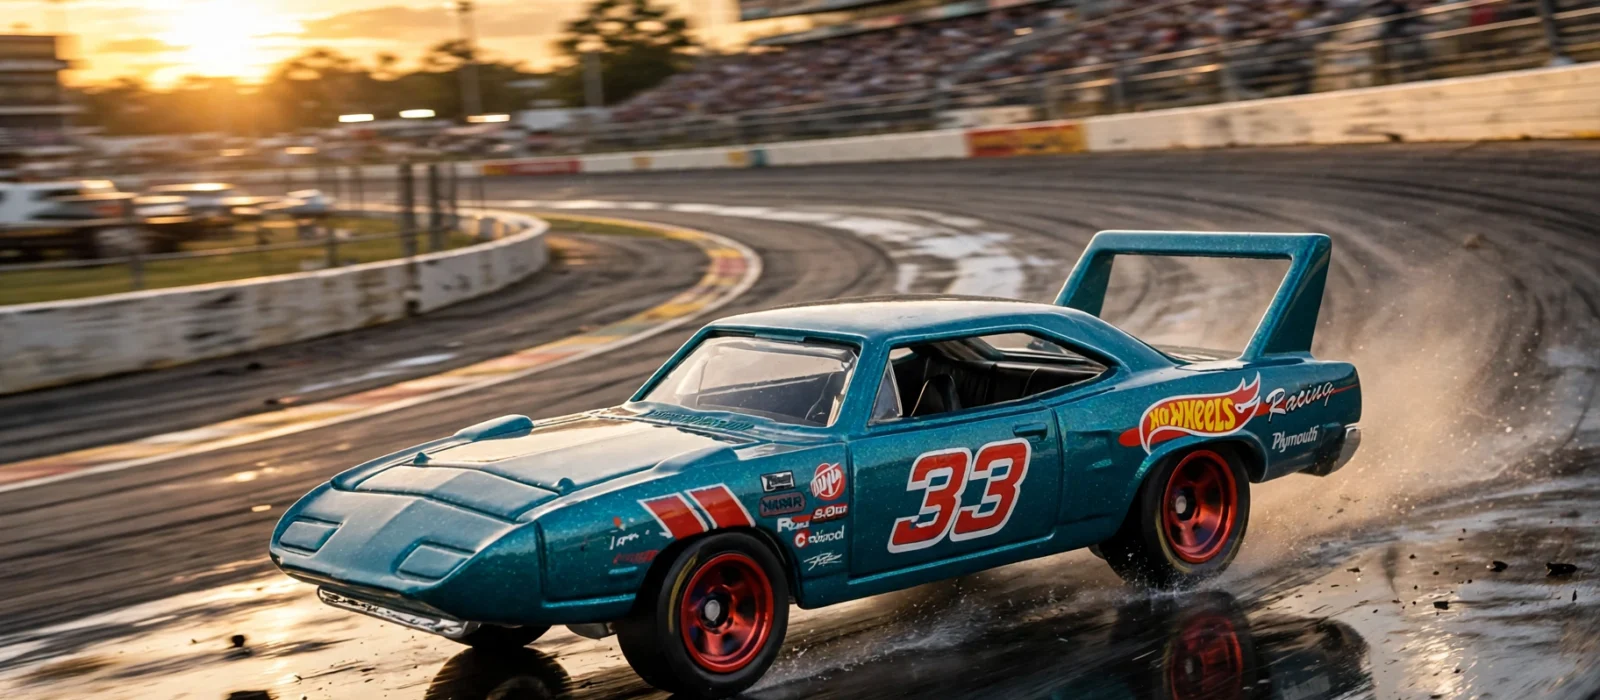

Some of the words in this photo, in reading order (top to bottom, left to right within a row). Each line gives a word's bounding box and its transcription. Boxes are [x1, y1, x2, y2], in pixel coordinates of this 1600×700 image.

[1265, 382, 1335, 422] Racing
[1271, 424, 1320, 453] Plymouth
[887, 437, 1032, 554] 33
